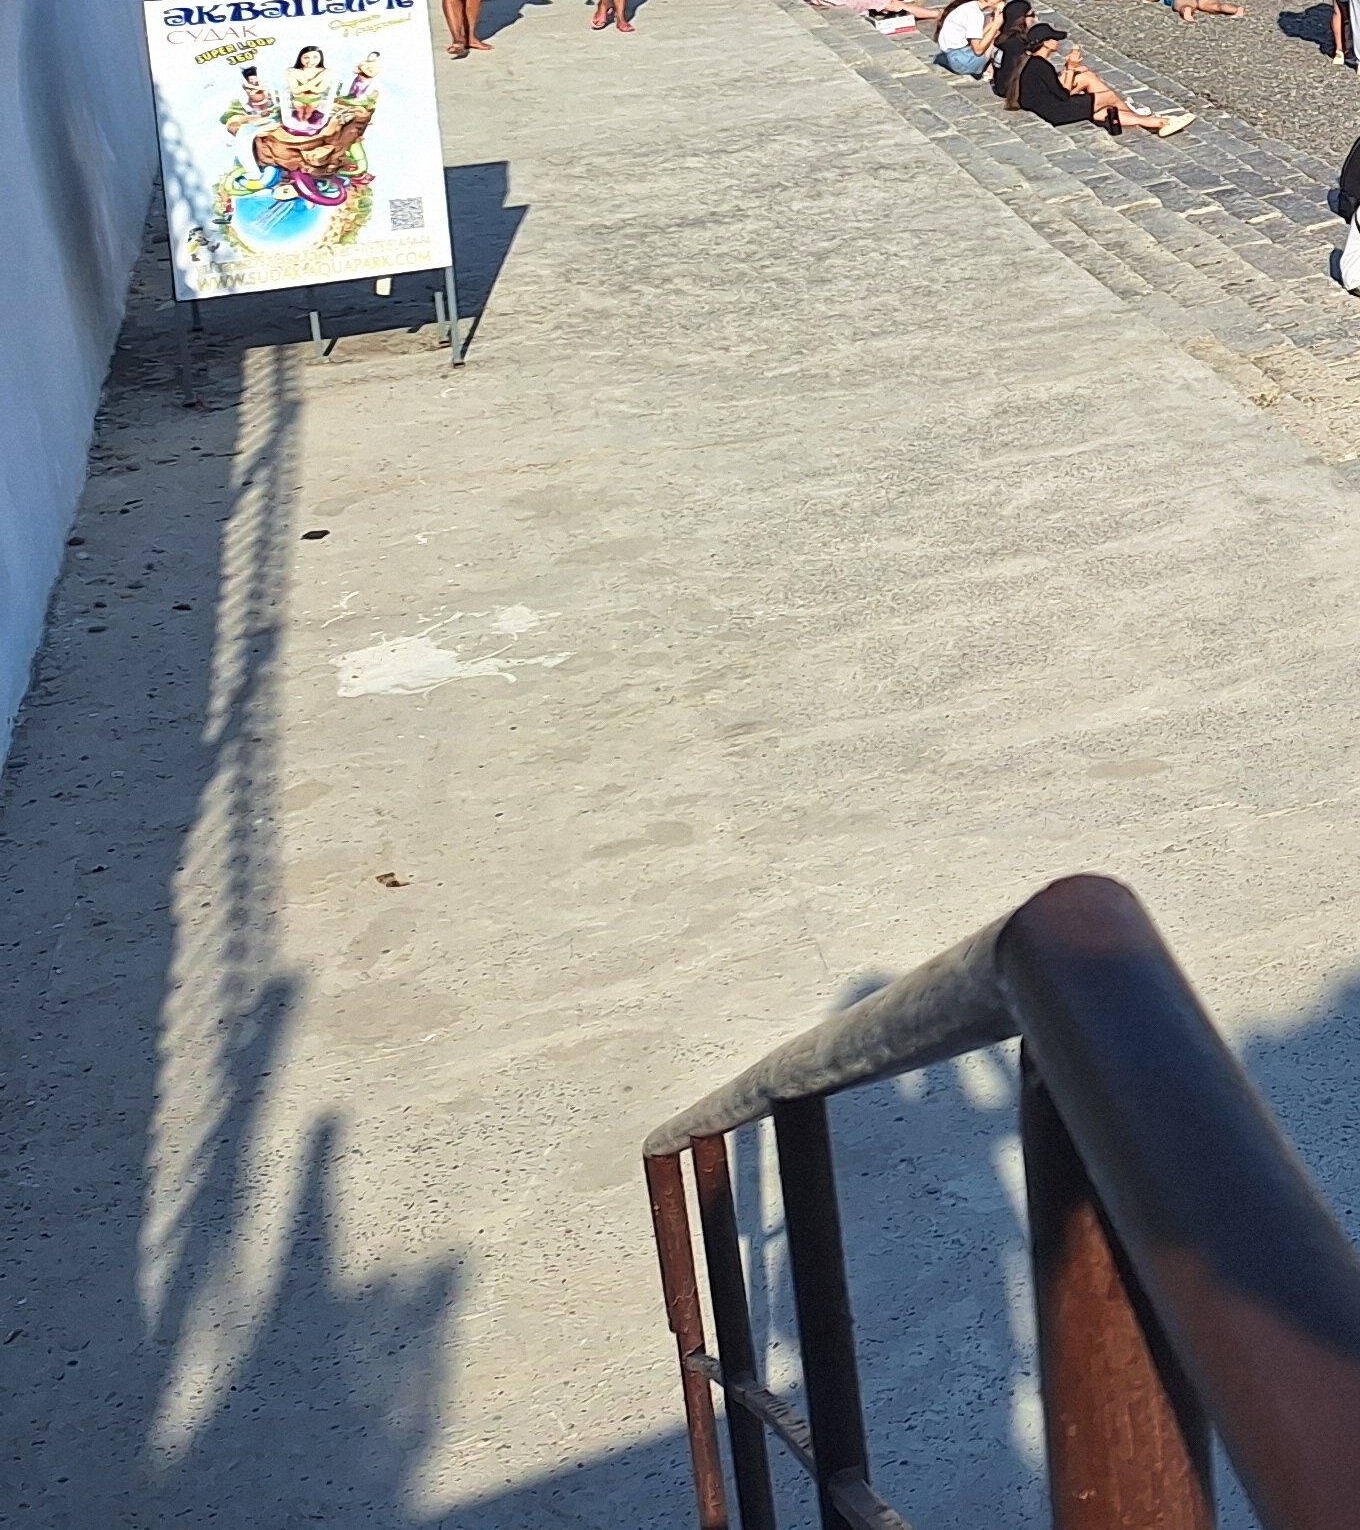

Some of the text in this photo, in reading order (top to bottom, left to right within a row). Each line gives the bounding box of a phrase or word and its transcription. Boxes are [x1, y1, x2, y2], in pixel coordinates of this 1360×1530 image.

[166, 24, 259, 45] СУДАК
[194, 36, 276, 65] SUPER LOOP
